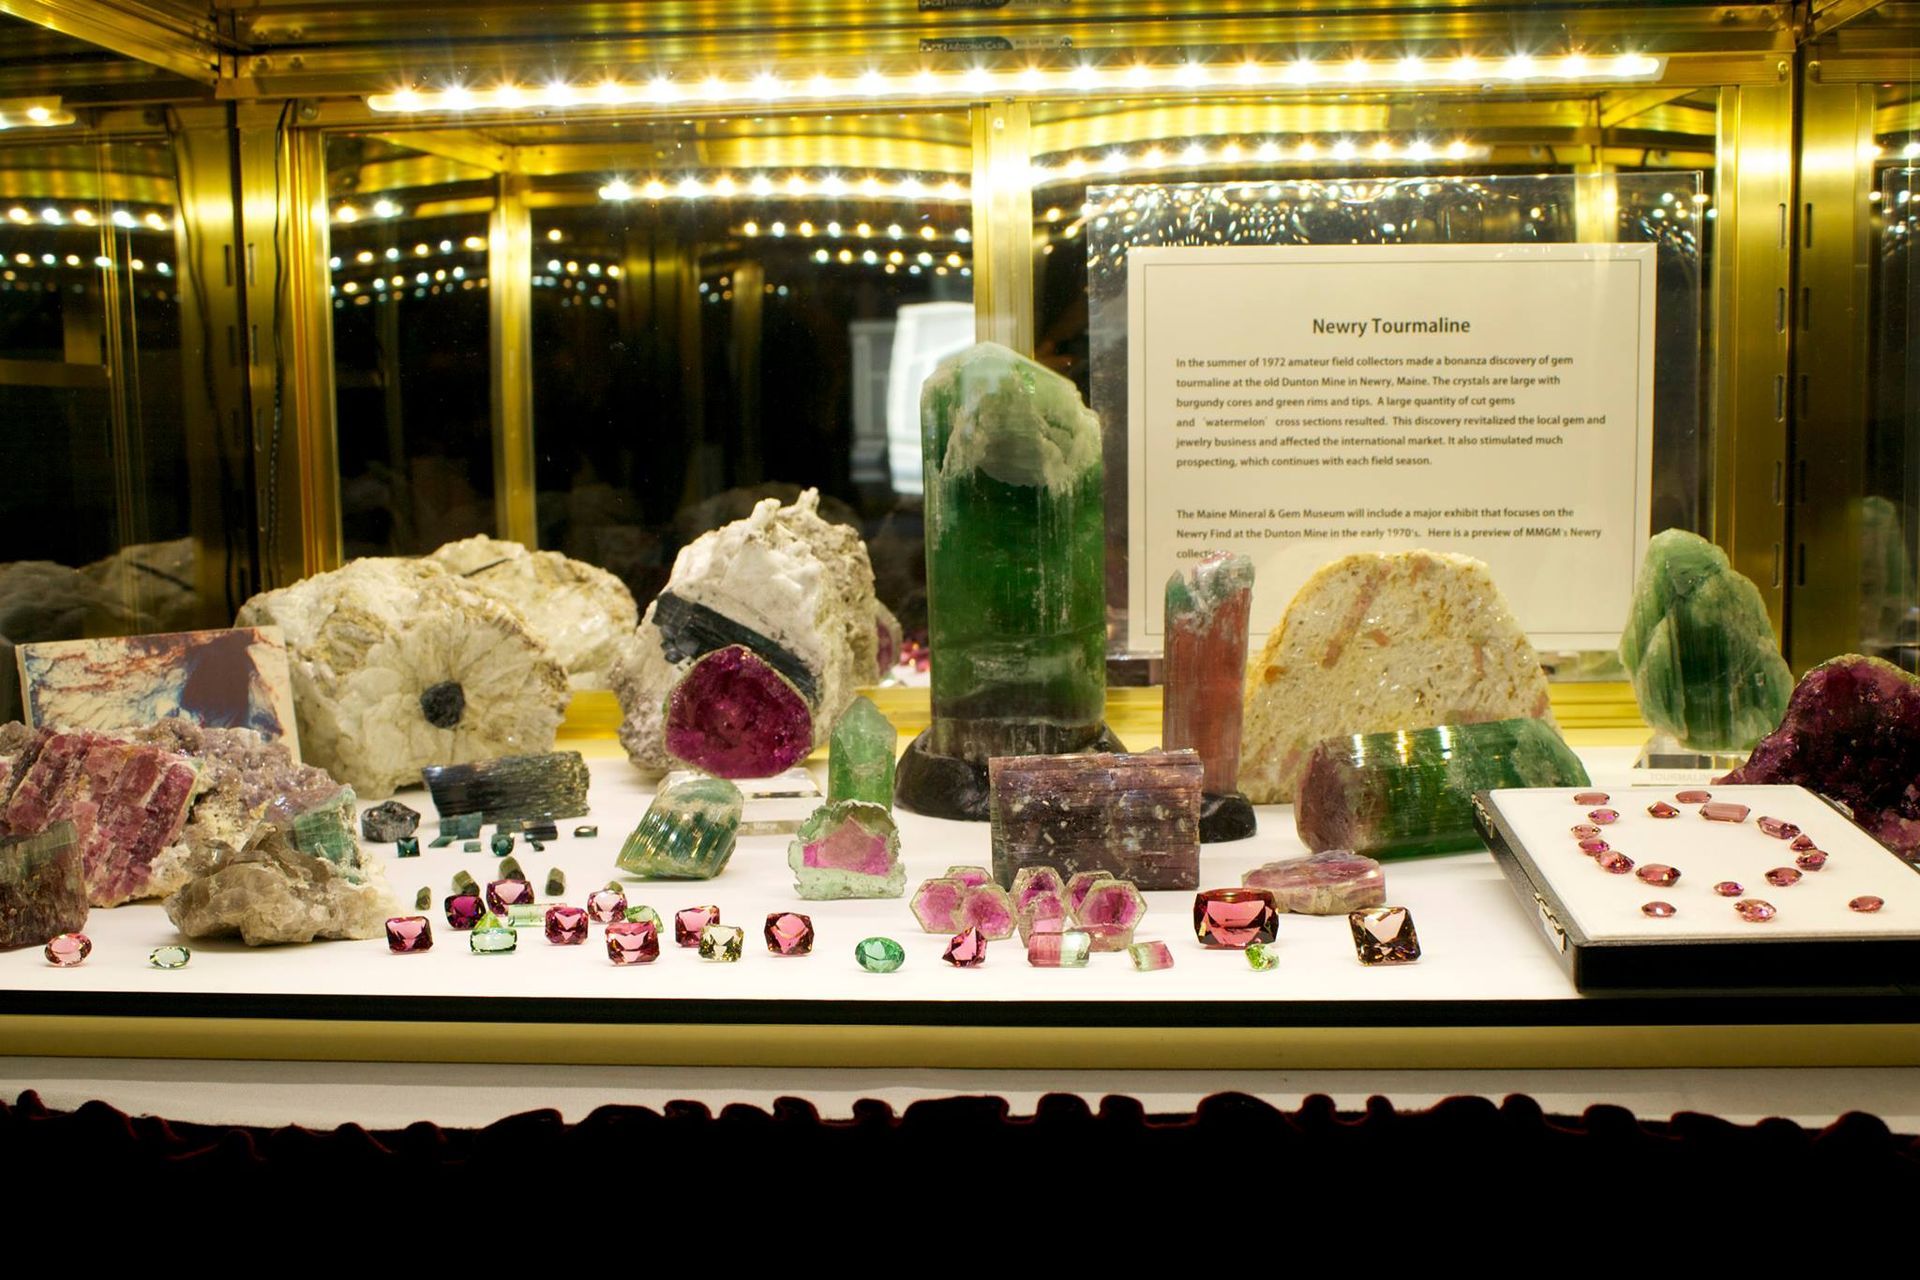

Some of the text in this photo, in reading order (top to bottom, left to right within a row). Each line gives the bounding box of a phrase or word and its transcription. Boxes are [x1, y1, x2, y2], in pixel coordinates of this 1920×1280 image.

[1313, 317, 1471, 338] Newry Tourmaline
[1176, 358, 1186, 367] In
[1188, 358, 1205, 367] the
[1249, 357, 1260, 367] of
[1262, 357, 1286, 367] 1972
[1288, 358, 1330, 366] amateur
[1331, 357, 1354, 366] field
[1356, 356, 1404, 366] collectors
[1406, 356, 1434, 366] made
[1444, 356, 1487, 366] bonanza
[1489, 356, 1537, 367] discovery
[1538, 355, 1549, 365] of
[1550, 357, 1574, 367] gem
[1175, 378, 1231, 387] tourmaline
[1232, 379, 1243, 387] at
[1244, 377, 1262, 387] the
[1263, 377, 1281, 387] old
[1281, 377, 1320, 387] Dunton
[1320, 377, 1347, 386] Mine
[1347, 378, 1358, 386] in
[1396, 377, 1431, 386] Maine.
[1431, 376, 1451, 385] The
[1452, 376, 1491, 387] crystals
[1509, 376, 1536, 388] large
[1537, 376, 1561, 384] with
[1176, 398, 1225, 409] burgundy
[1254, 398, 1275, 407] and
[1275, 399, 1305, 409] green
[1306, 398, 1329, 406] rims
[1330, 397, 1350, 406] and
[1351, 397, 1373, 408] tips.
[1376, 397, 1385, 405] A
[1386, 397, 1413, 408] large
[1413, 397, 1457, 407] quantity
[1457, 396, 1469, 405] of
[1470, 397, 1487, 405] cut
[1488, 398, 1516, 407] gems
[1175, 418, 1196, 427] and
[1301, 417, 1344, 426] sections
[1344, 416, 1389, 426] resulted.
[1391, 416, 1413, 425] This
[1414, 416, 1463, 427] discovery
[1463, 416, 1517, 425] revitalized
[1517, 416, 1536, 425] the
[1536, 415, 1561, 425] local
[1561, 417, 1586, 427] gem
[1585, 415, 1607, 424] and
[1175, 435, 1564, 449] jewelry business and affected the international market. It also stimulated much
[1239, 457, 1270, 466] which
[1271, 458, 1321, 466] continues
[1321, 456, 1345, 465] with
[1345, 456, 1370, 465] each
[1370, 456, 1394, 465] field
[1176, 510, 1195, 518] The
[1196, 510, 1228, 519] Maine
[1228, 509, 1267, 518] Mineral
[1267, 509, 1277, 518] &
[1277, 509, 1302, 518] Gem
[1302, 509, 1346, 518] Museum
[1346, 509, 1365, 518] will
[1366, 509, 1404, 518] include
[1412, 509, 1443, 520] major
[1443, 508, 1479, 517] exhibit
[1480, 508, 1502, 517] that
[1502, 508, 1541, 517] focuses
[1557, 508, 1575, 517] the
[1176, 530, 1209, 540] Newry
[1209, 529, 1233, 538] Find
[1233, 530, 1245, 538] at
[1245, 529, 1263, 538] the
[1263, 529, 1302, 538] Dunton
[1302, 529, 1329, 538] Mine
[1329, 529, 1340, 537] in
[1341, 529, 1359, 537] the
[1359, 528, 1386, 538] early
[1427, 528, 1452, 537] Here
[1452, 529, 1462, 537] is
[1470, 528, 1512, 539] preview
[1512, 527, 1525, 537] of
[1569, 528, 1602, 538] Newry
